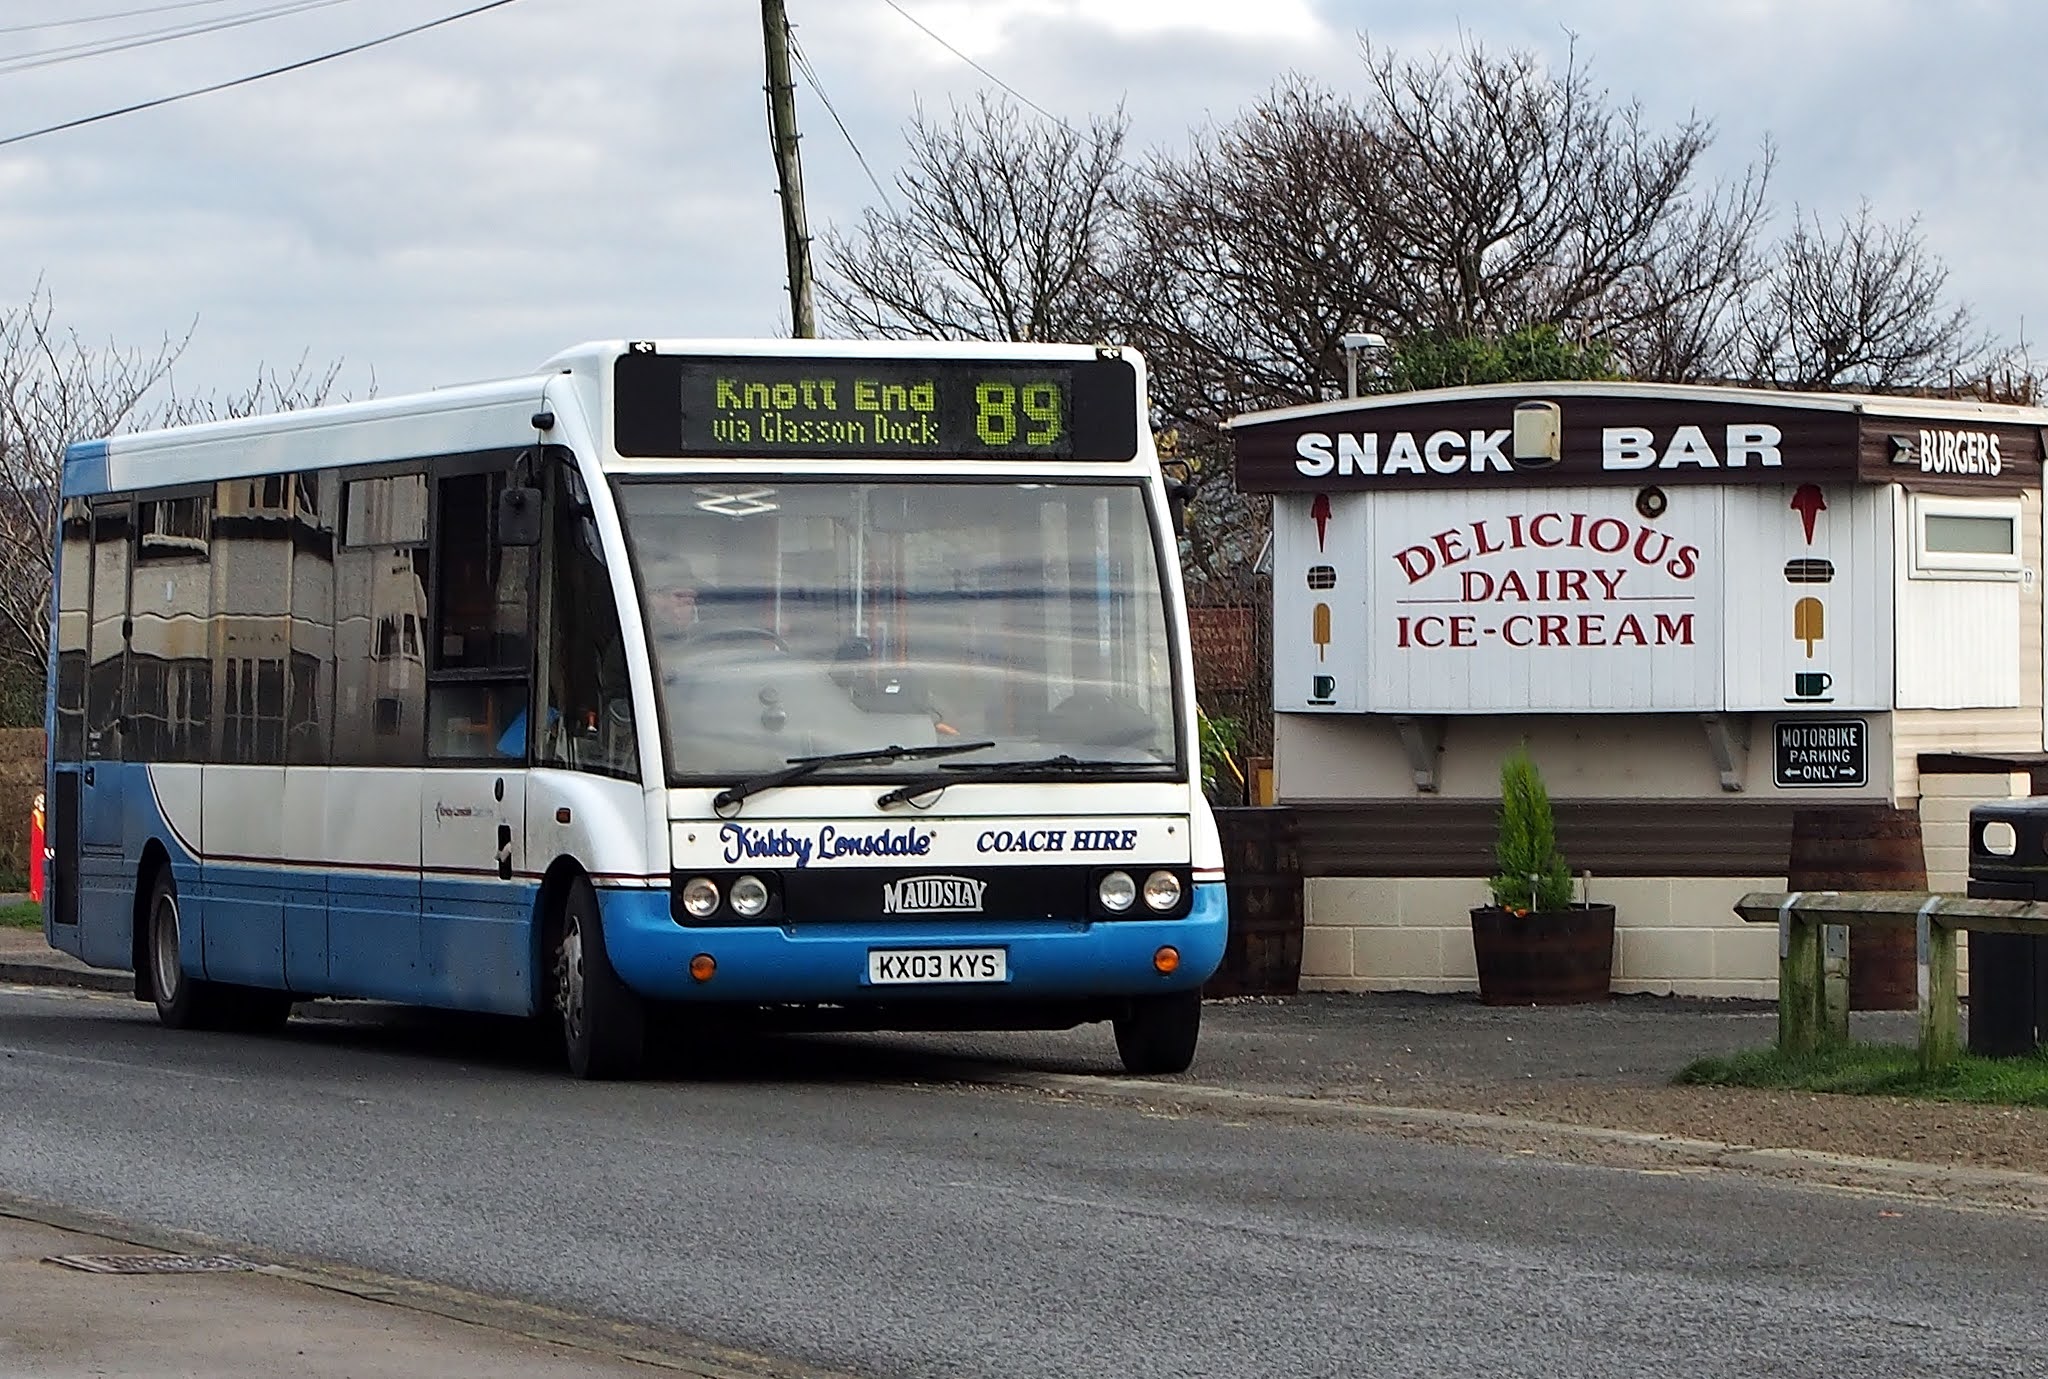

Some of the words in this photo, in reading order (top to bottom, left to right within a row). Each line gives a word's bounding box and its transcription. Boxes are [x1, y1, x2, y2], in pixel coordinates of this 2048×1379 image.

[716, 379, 837, 410] Knott
[855, 379, 935, 411] End
[713, 412, 750, 442] via
[761, 412, 864, 443] Glasson
[875, 413, 939, 444] Dock
[976, 380, 1062, 446] 89
[1296, 430, 1514, 477] SNACK
[1603, 424, 1783, 470] BAR
[1919, 429, 2002, 476] BURGERS
[1393, 513, 1700, 585] DELICIOUS
[1460, 569, 1627, 602] DAIRY
[1397, 613, 1696, 649] ICE-CREAM
[1782, 727, 1858, 747] MOTORBIKE
[1790, 749, 1851, 763] PARKING
[1802, 765, 1838, 779] ONLY
[720, 823, 813, 868] Kirkby
[817, 826, 930, 859] Lonsdale
[977, 831, 1065, 853] COACH
[1071, 830, 1138, 852] HIRE
[883, 875, 988, 914] MAUDSLAY
[880, 956, 942, 979] KX03
[949, 955, 996, 978] KYS
